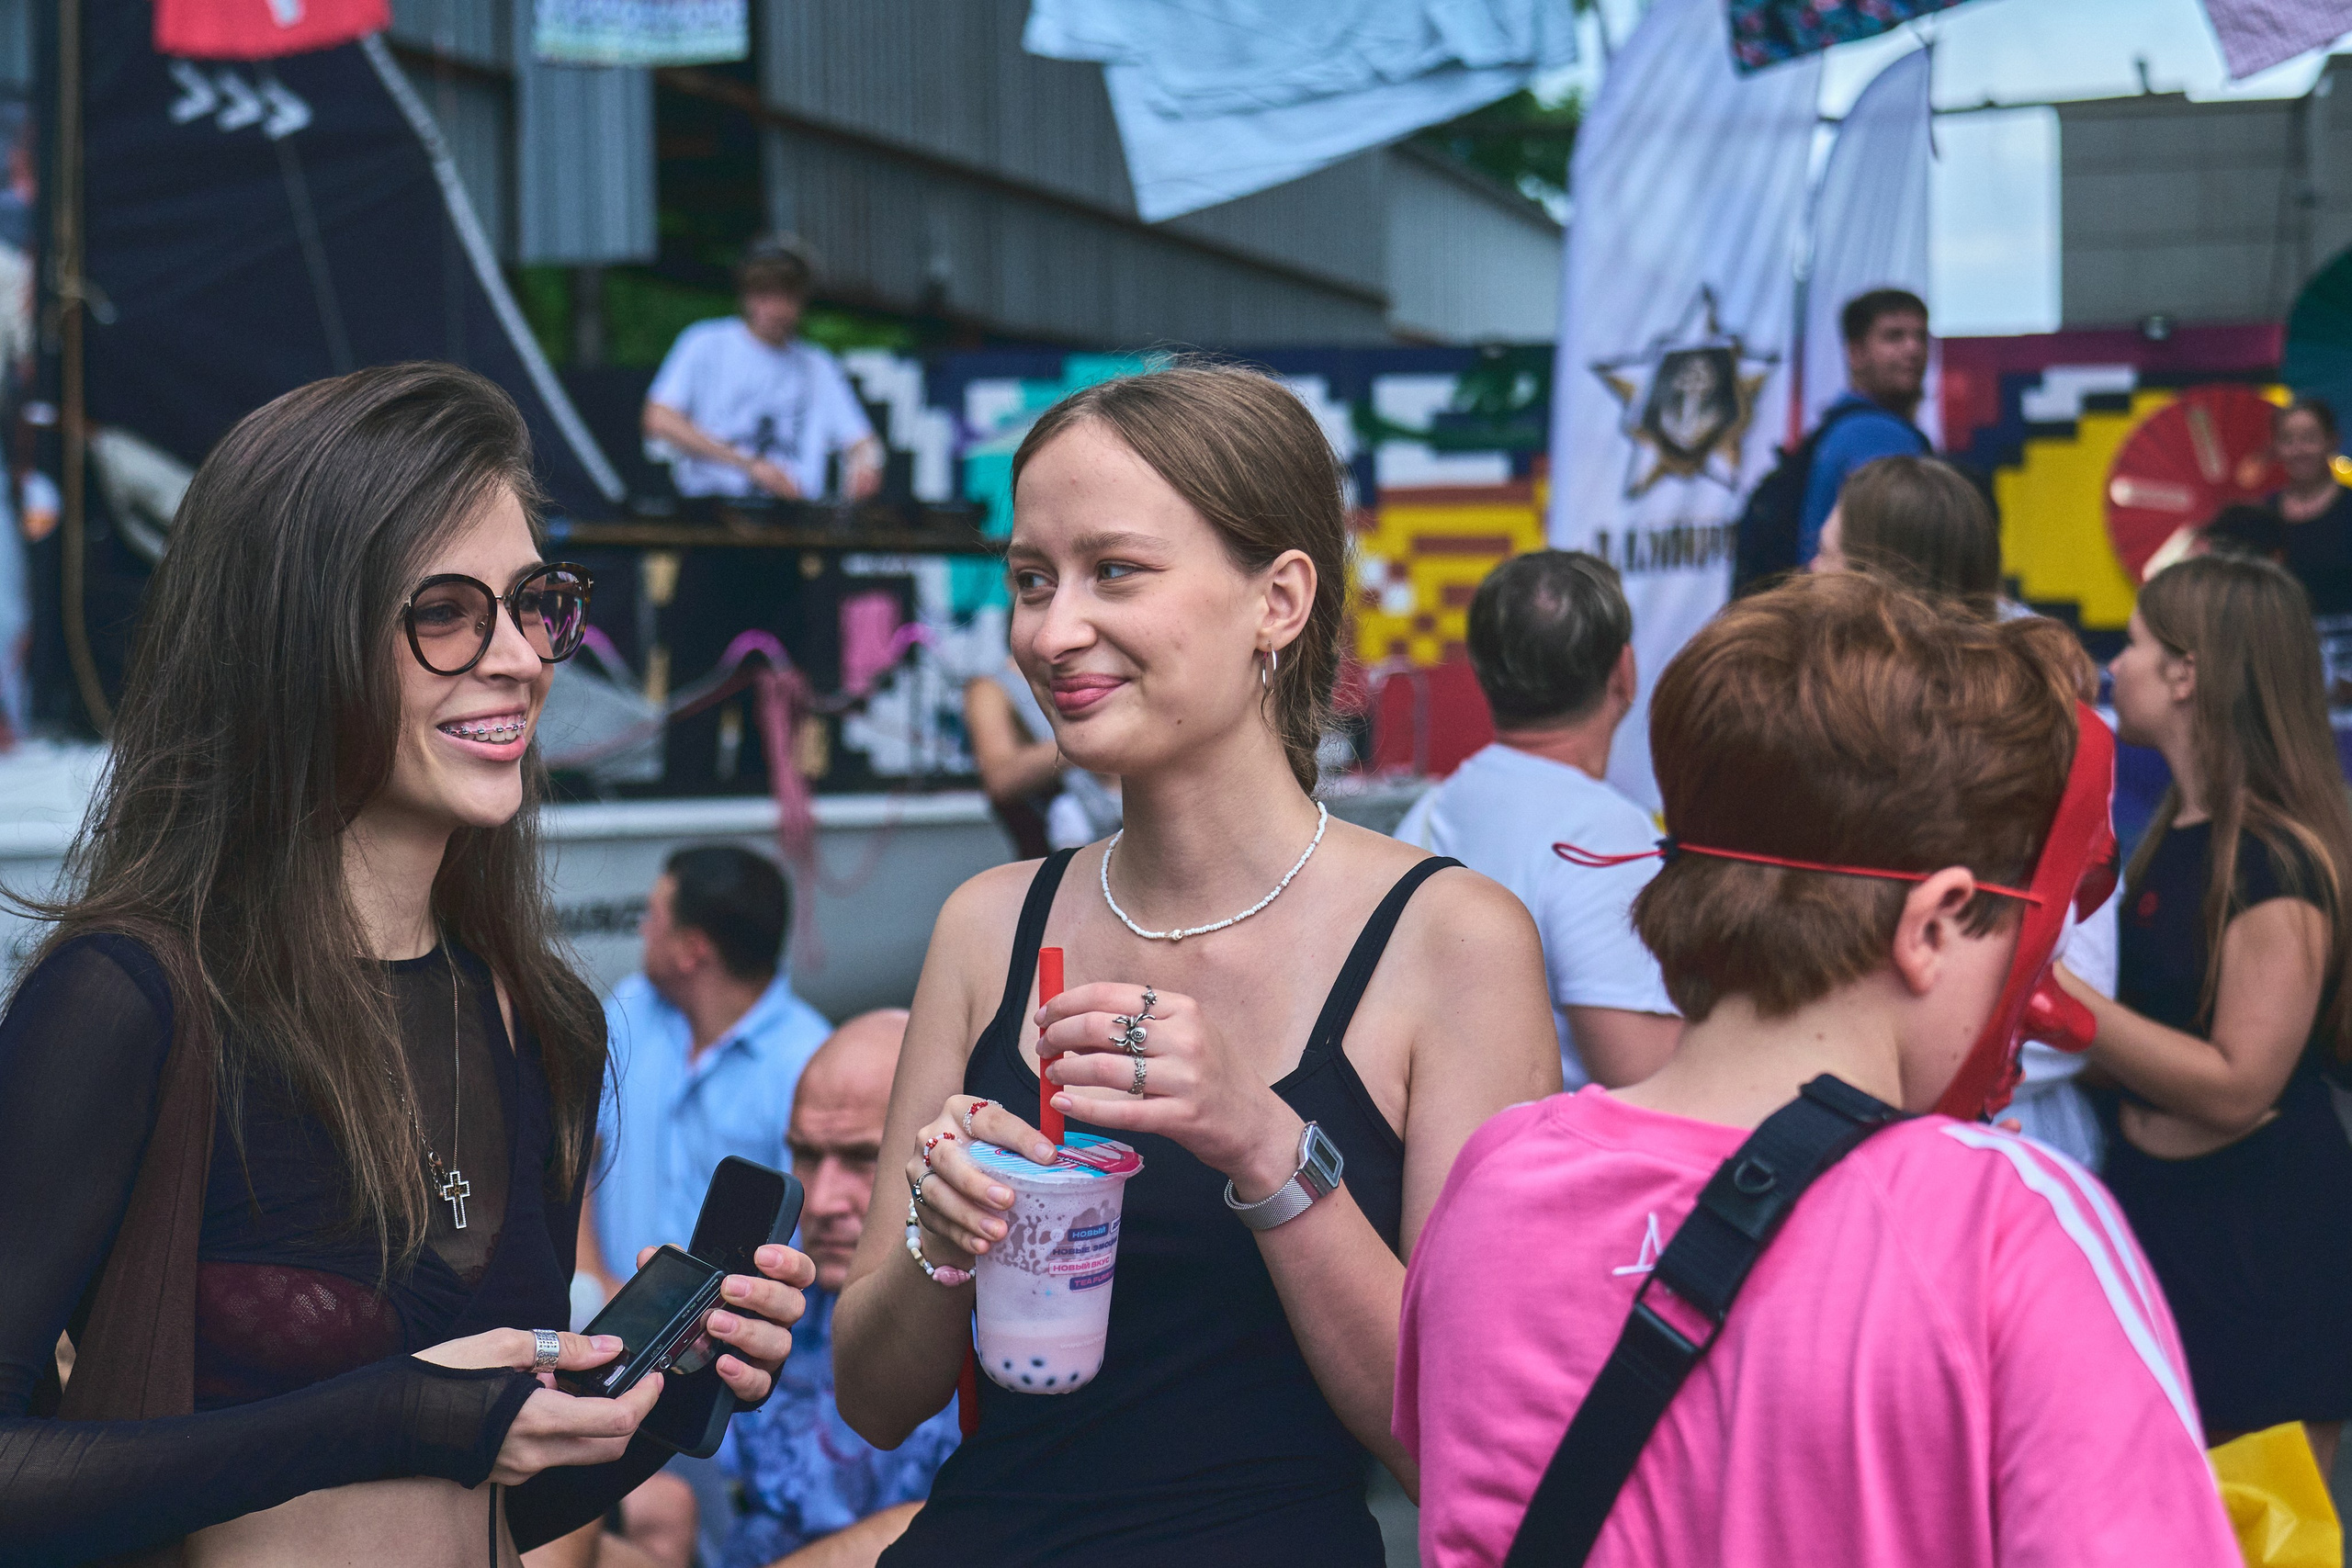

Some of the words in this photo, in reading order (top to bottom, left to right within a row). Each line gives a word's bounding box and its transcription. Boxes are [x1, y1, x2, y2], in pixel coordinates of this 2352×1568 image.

[1072, 1226, 1106, 1238] НОВЫЙ
[1053, 1247, 1091, 1256] НОВЫЕ
[1093, 1235, 1117, 1251] ЭМОЦИ
[1053, 1261, 1091, 1272] НОВЫЙ
[1091, 1257, 1110, 1268] ВКУС
[1074, 1278, 1092, 1287] TEA
